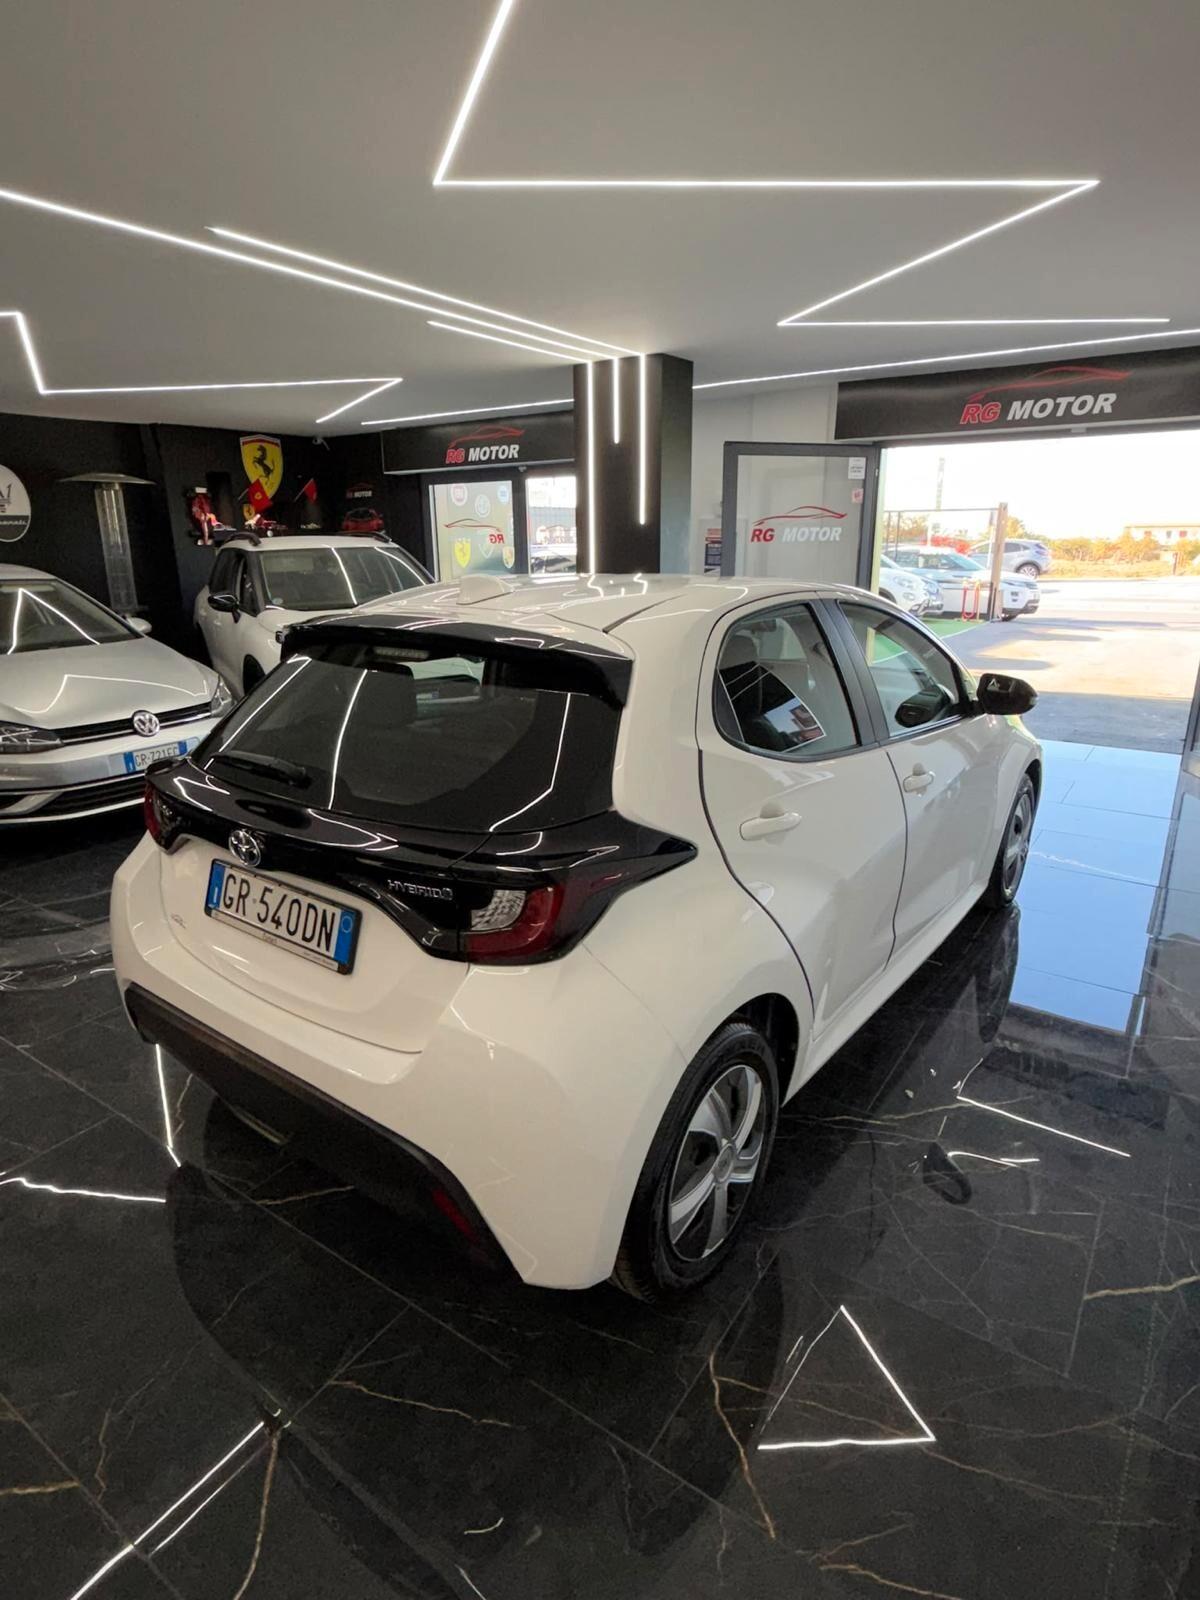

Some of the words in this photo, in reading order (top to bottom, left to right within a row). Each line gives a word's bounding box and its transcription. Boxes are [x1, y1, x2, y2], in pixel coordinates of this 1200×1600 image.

[960, 402, 1002, 424] RG
[1007, 393, 1117, 421] MOTOR
[446, 449, 465, 464] RG
[468, 444, 519, 462] MOTOR
[751, 528, 775, 542] RG
[782, 527, 842, 542] MOTOR
